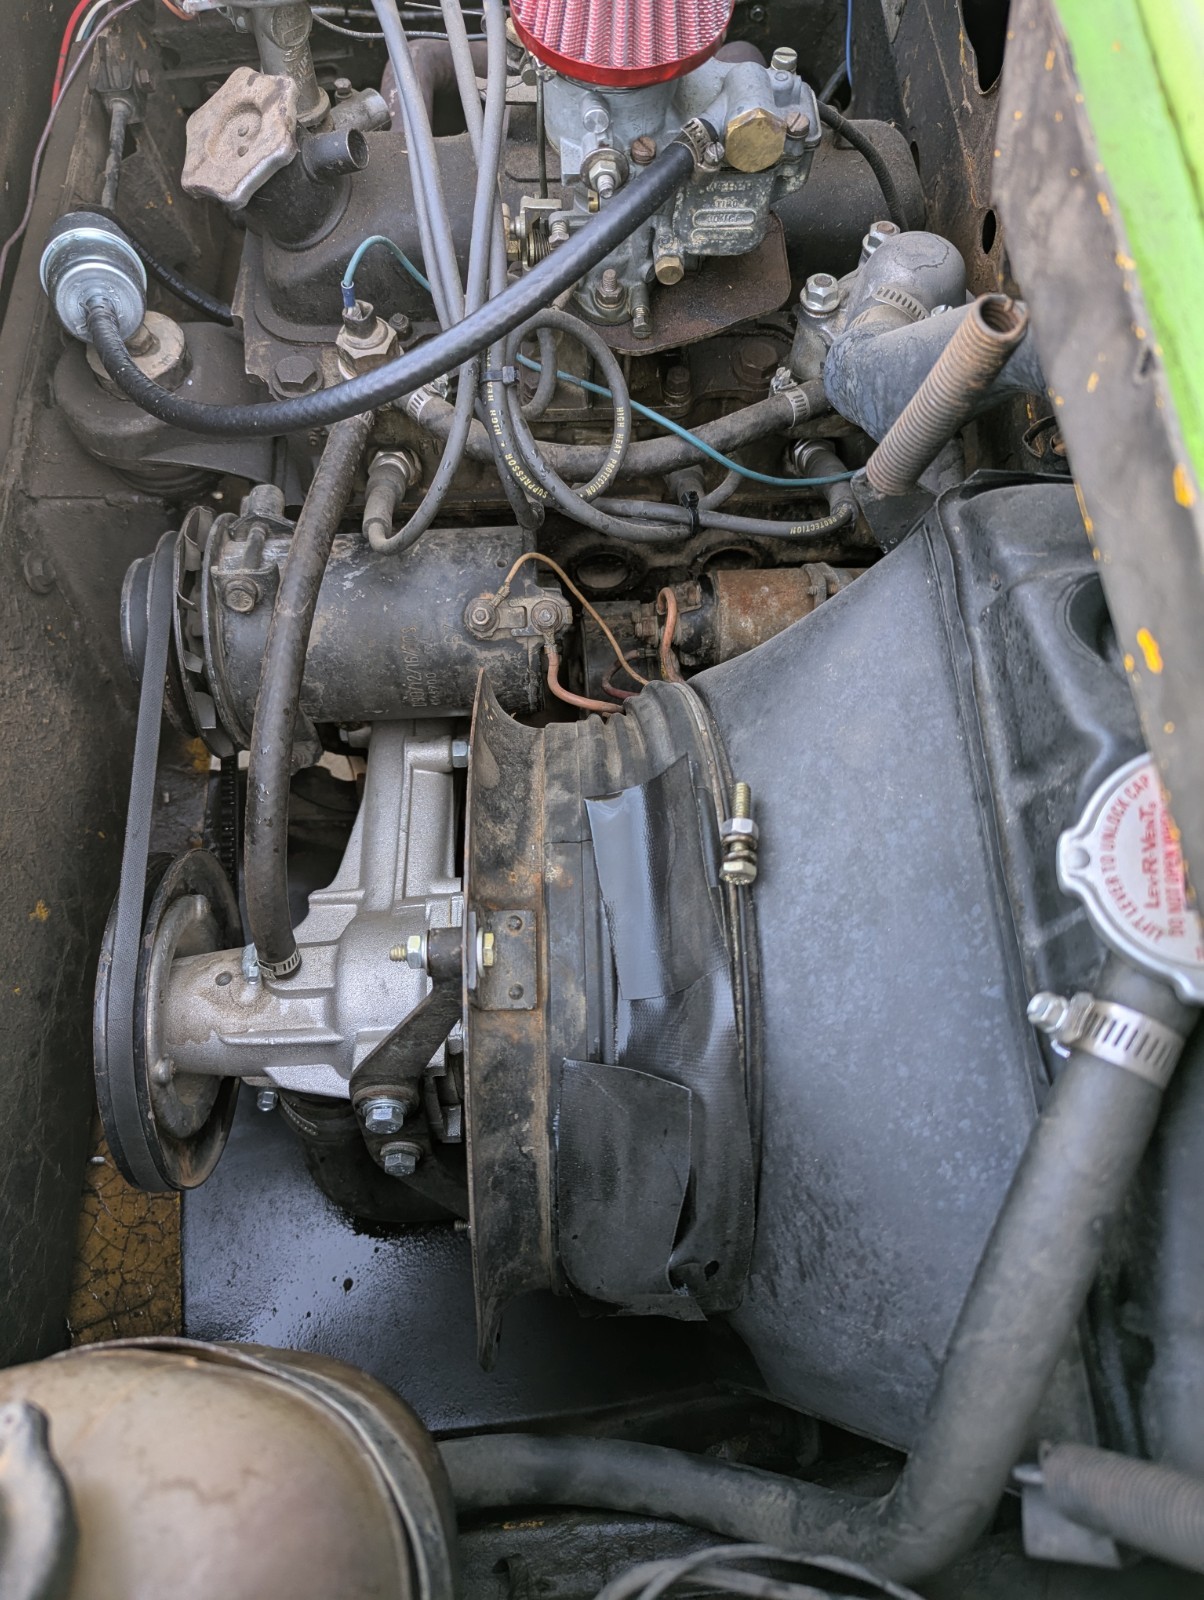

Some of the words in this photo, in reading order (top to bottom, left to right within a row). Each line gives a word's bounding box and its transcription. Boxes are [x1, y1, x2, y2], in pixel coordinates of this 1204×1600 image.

[486, 381, 495, 402] HEA
[489, 409, 503, 435] HIGH
[616, 406, 626, 428] HIGH
[614, 433, 625, 455] HEAT
[504, 453, 549, 499] SUPPRESSOR
[585, 458, 618, 497] PROTECTION
[789, 516, 838, 535] PROTECTION
[1124, 774, 1150, 800] CAP
[1102, 798, 1129, 852] UNLOCK
[1100, 854, 1116, 873] TO
[1163, 849, 1182, 884] OPEN
[1105, 876, 1137, 918] LEVER
[1165, 887, 1182, 915] NOT
[1133, 915, 1164, 944] LIFT
[1168, 917, 1186, 938] DO
